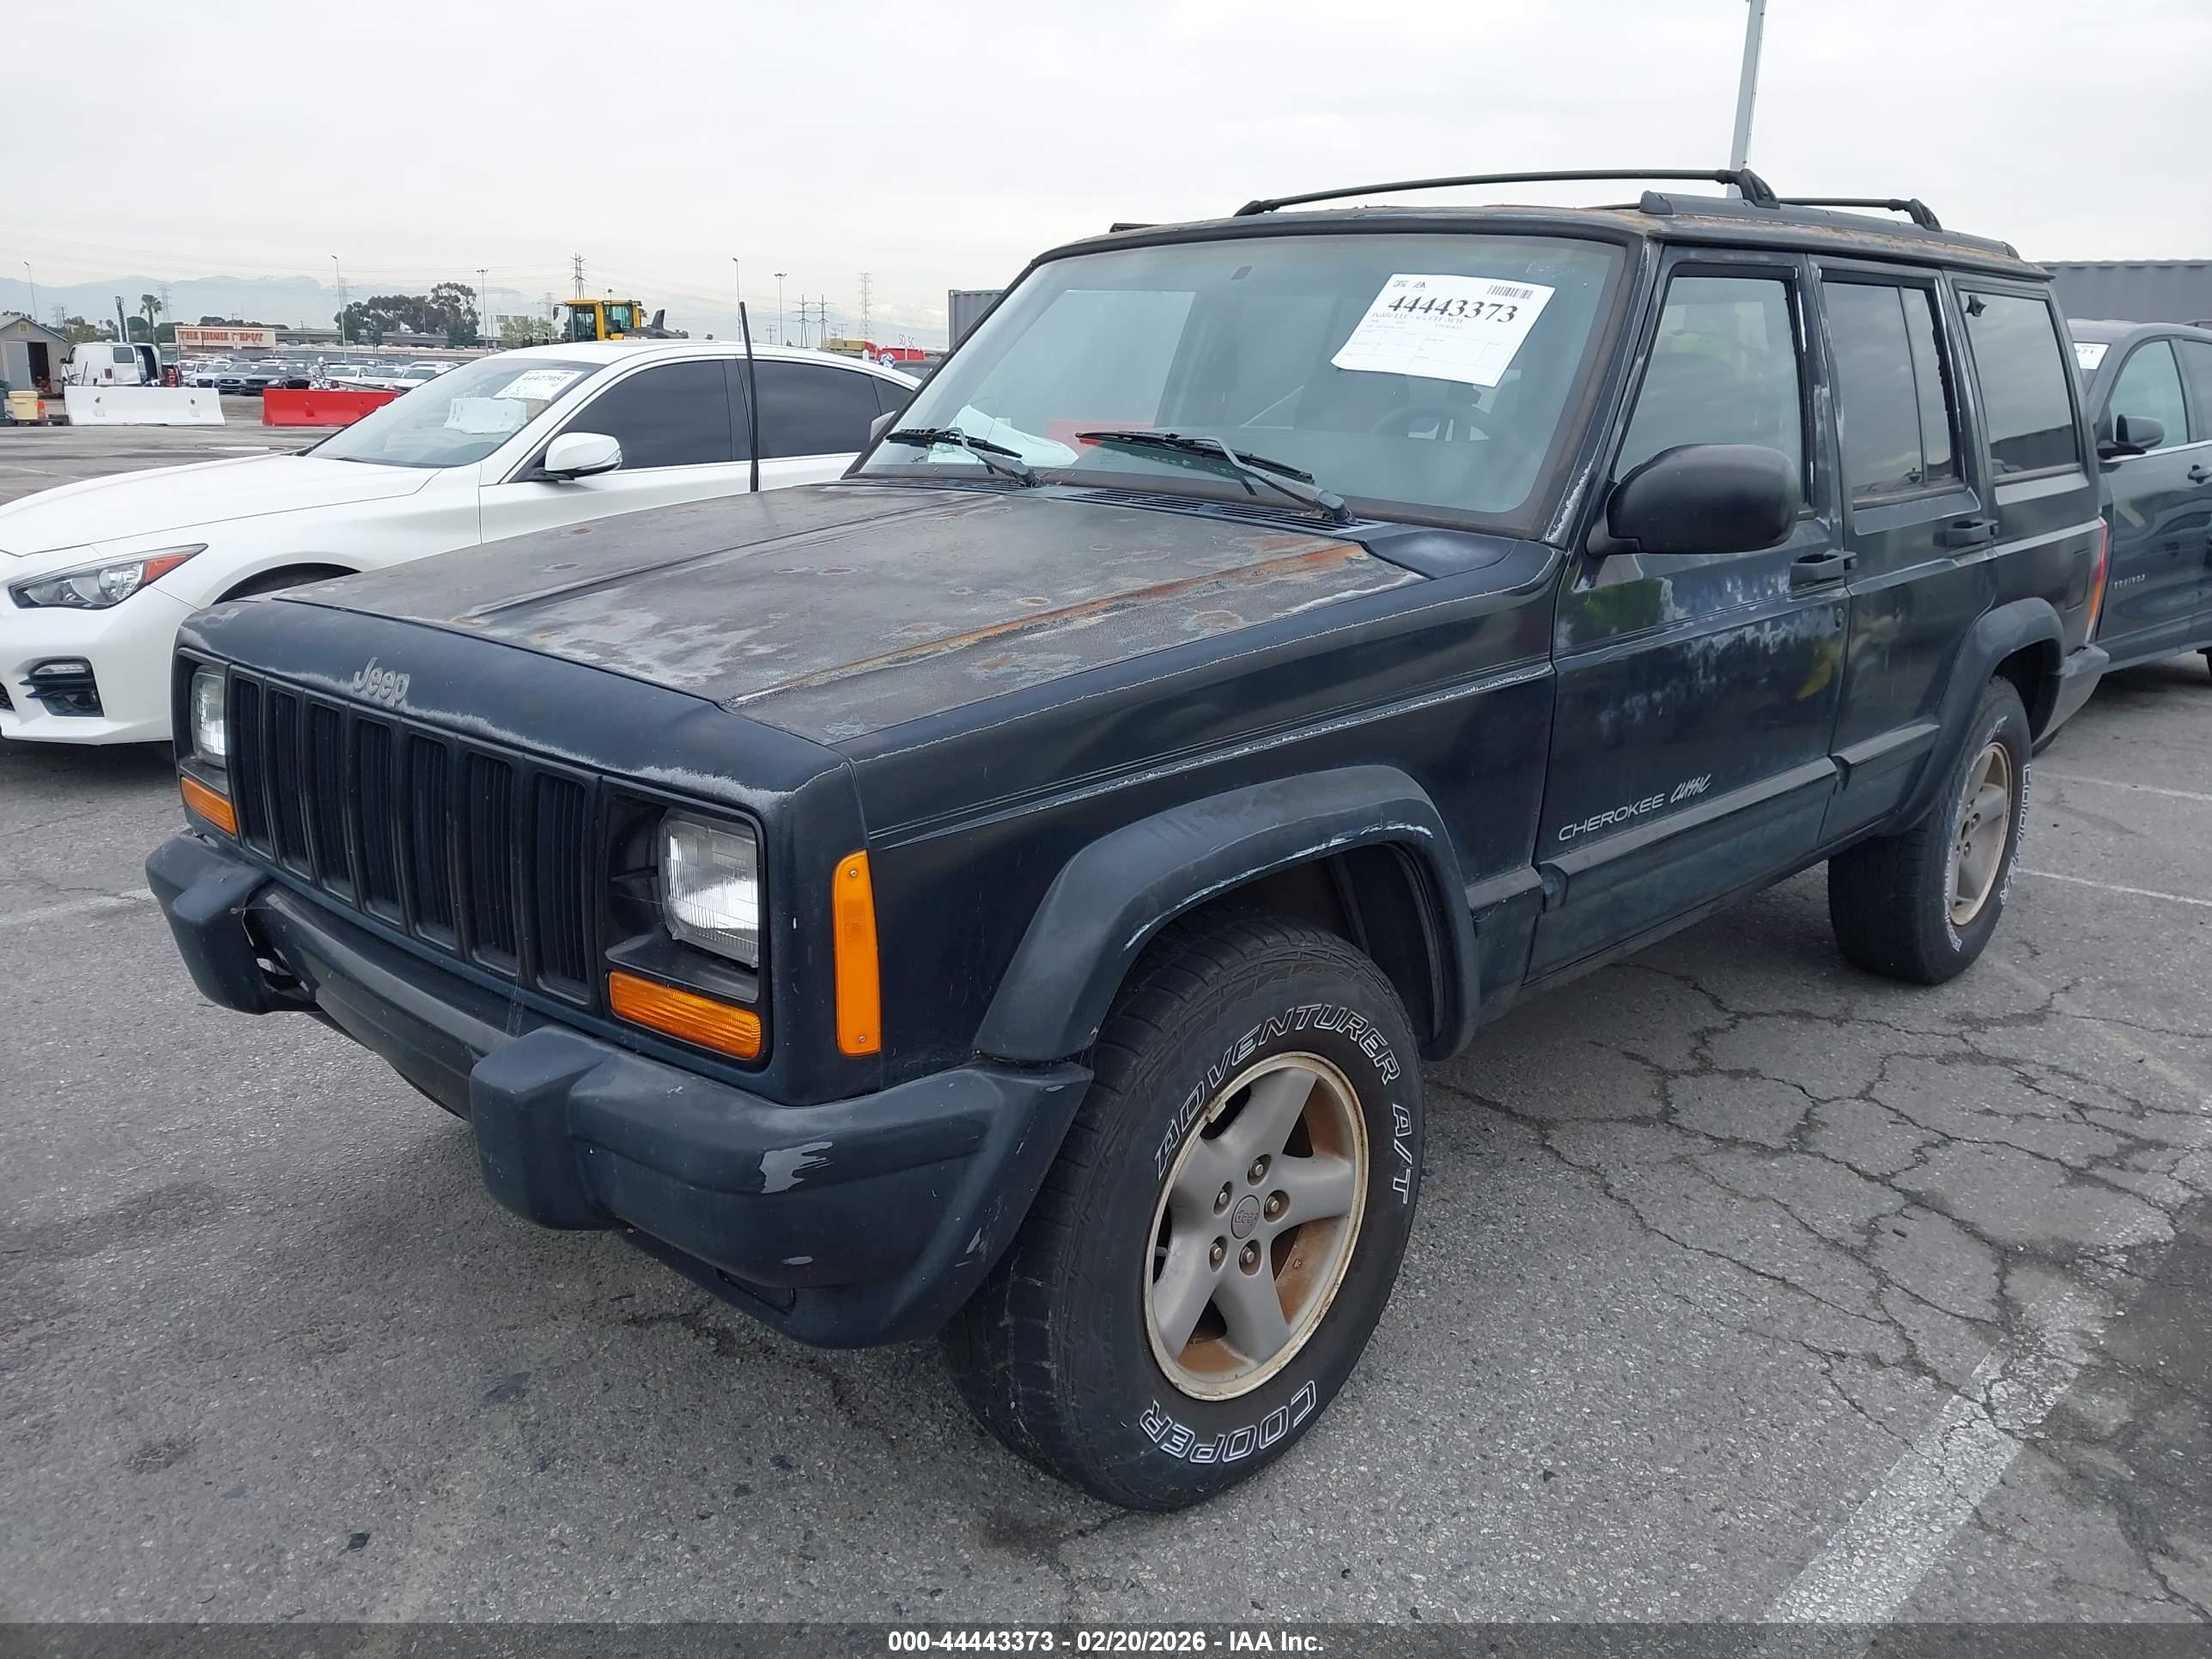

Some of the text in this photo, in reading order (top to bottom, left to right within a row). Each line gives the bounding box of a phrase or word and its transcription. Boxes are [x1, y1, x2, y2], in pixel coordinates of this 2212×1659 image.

[1388, 295, 1518, 323] 44443373
[179, 331, 198, 340] THE
[353, 657, 410, 708] Jeep
[1559, 793, 1666, 842] CHEROKEE
[1153, 1003, 1413, 1205] ADVENTURER A/T
[1139, 1380, 1319, 1465] COOPER
